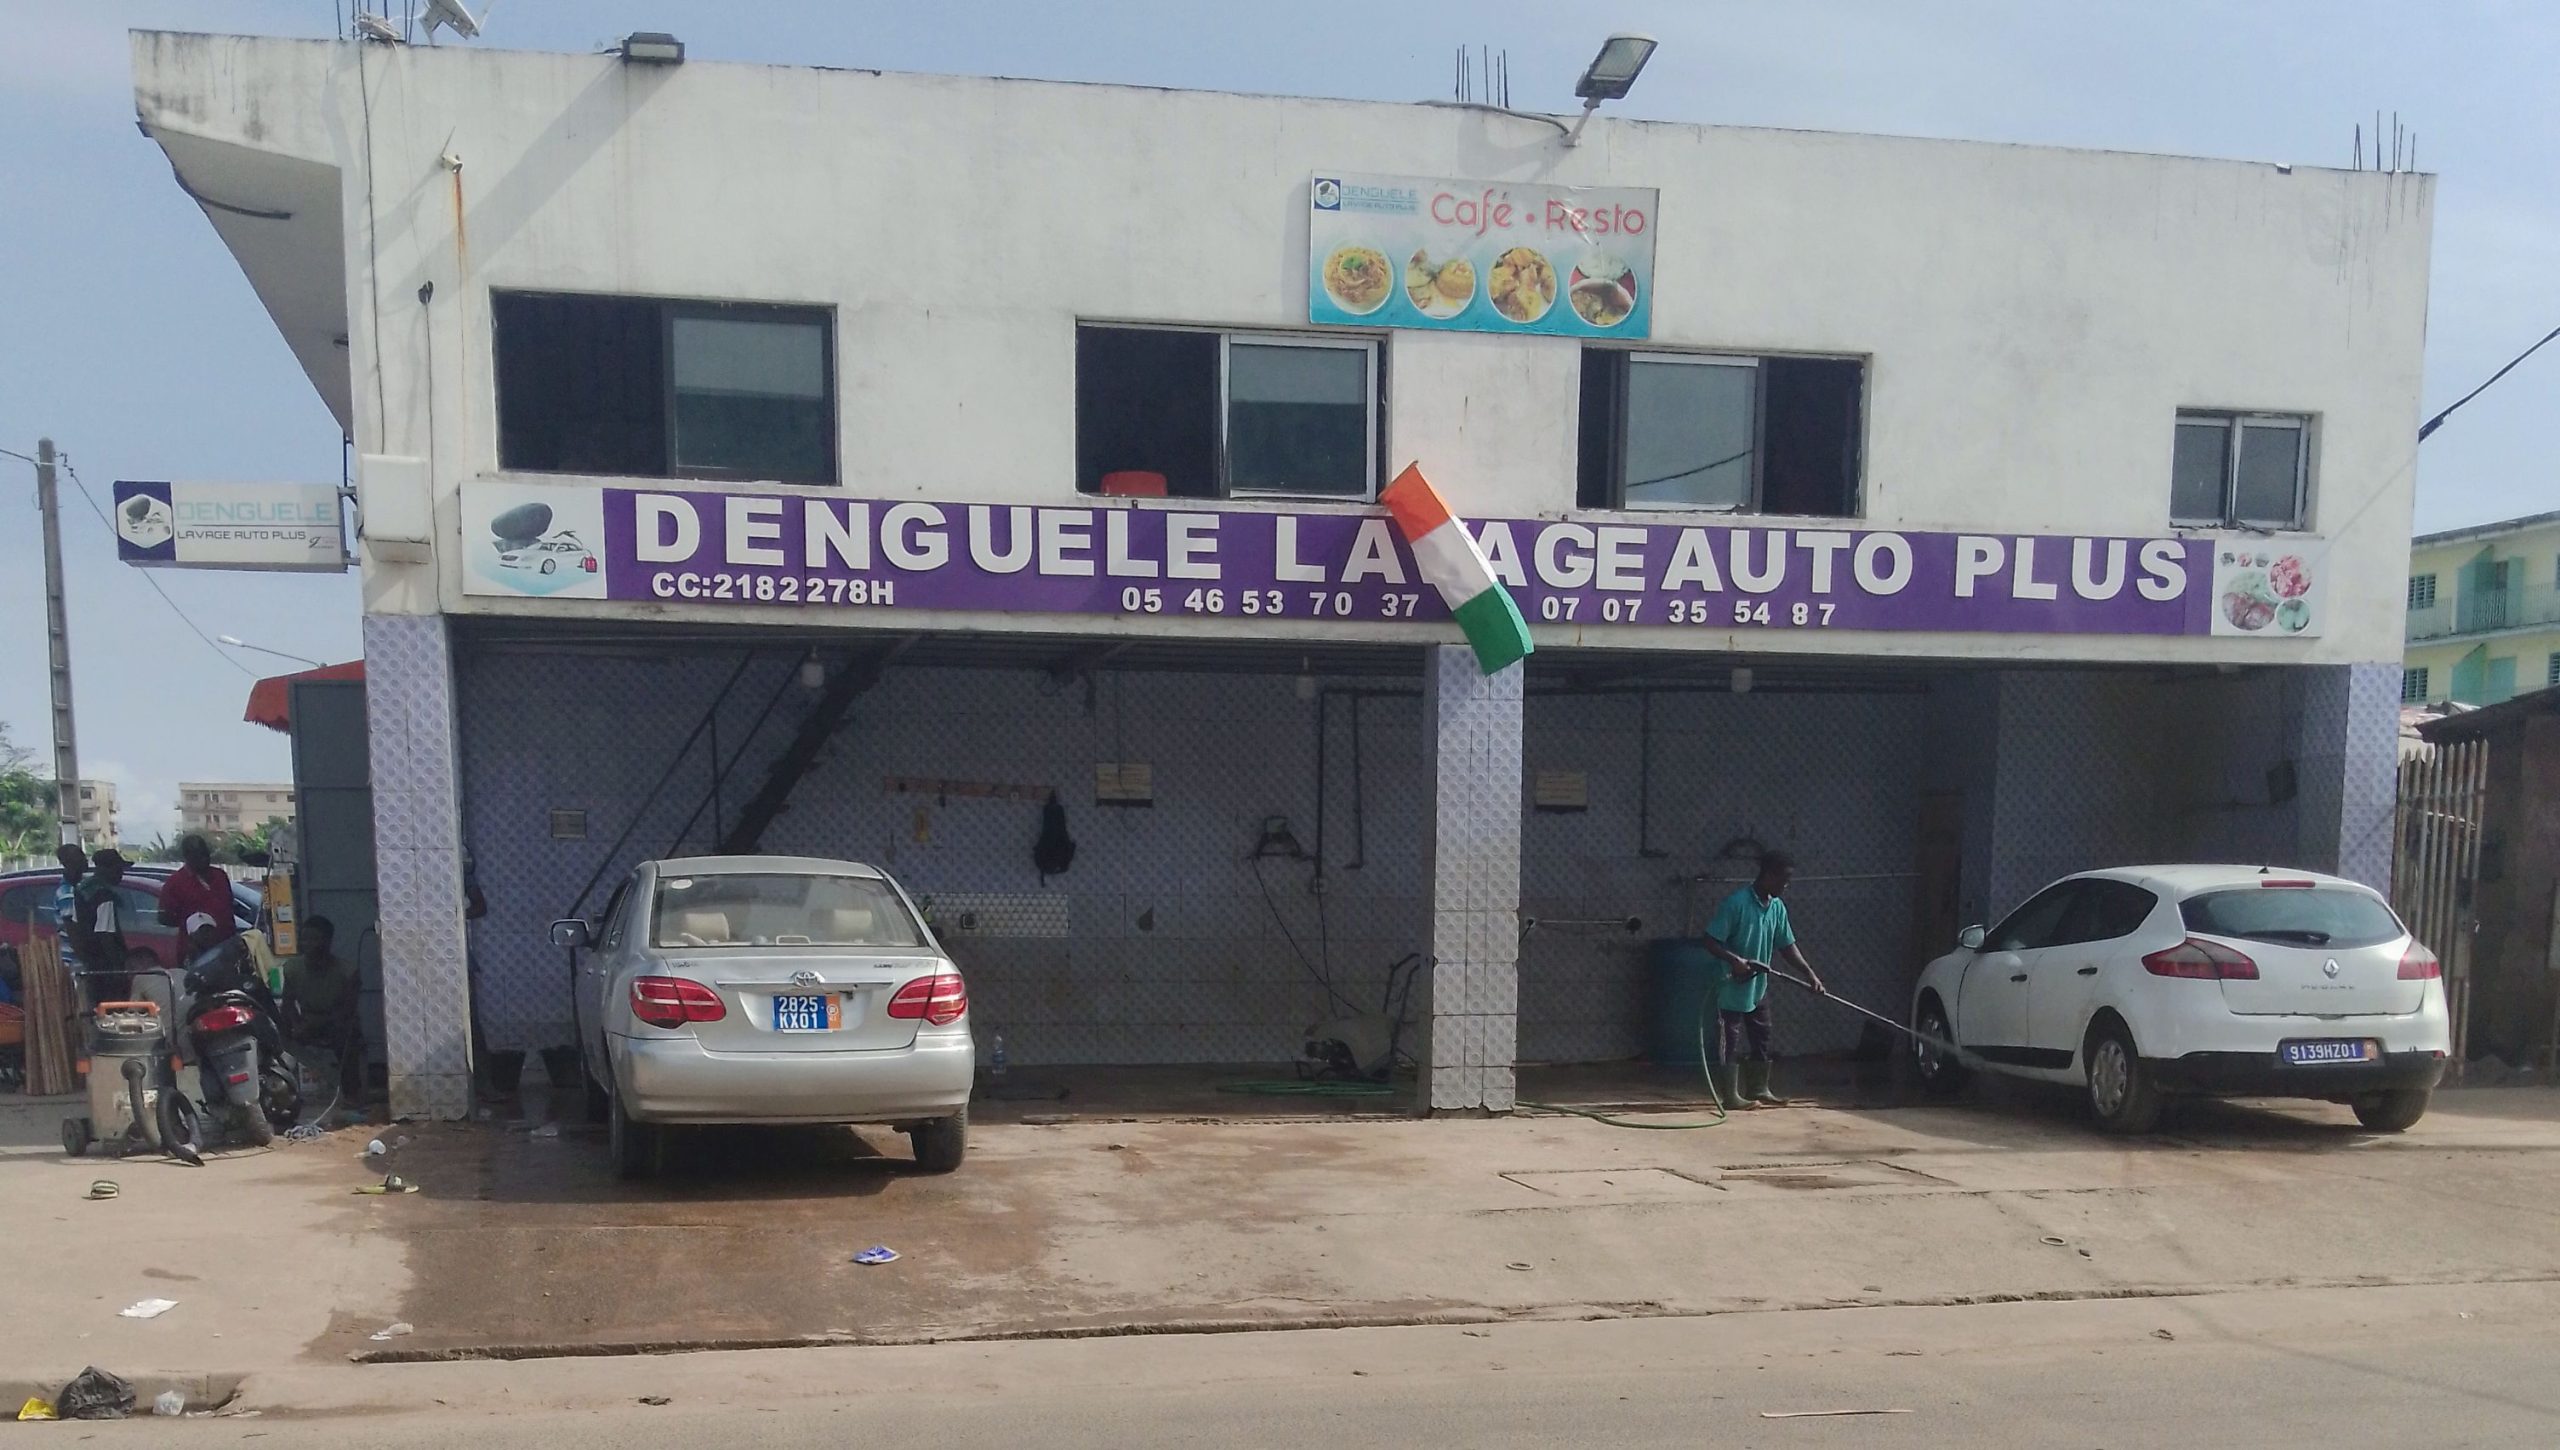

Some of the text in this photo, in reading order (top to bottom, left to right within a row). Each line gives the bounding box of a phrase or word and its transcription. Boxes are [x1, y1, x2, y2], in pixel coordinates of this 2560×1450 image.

[1431, 188, 1645, 237] Café Resto
[176, 502, 333, 522] DENGUELE
[177, 530, 306, 540] LAVAGE AUTO PLUS
[635, 493, 1222, 580] DENGUELE
[1661, 528, 1914, 596] AUTO
[1954, 535, 2187, 601] PLUS
[652, 572, 894, 605] CC:2182278H
[1122, 586, 1836, 626] 05 46 53 70 37 07 07 35 54 87
[779, 996, 818, 1012] 2825
[779, 1012, 818, 1029] KX01
[2290, 1043, 2357, 1060] 9139HZ01
